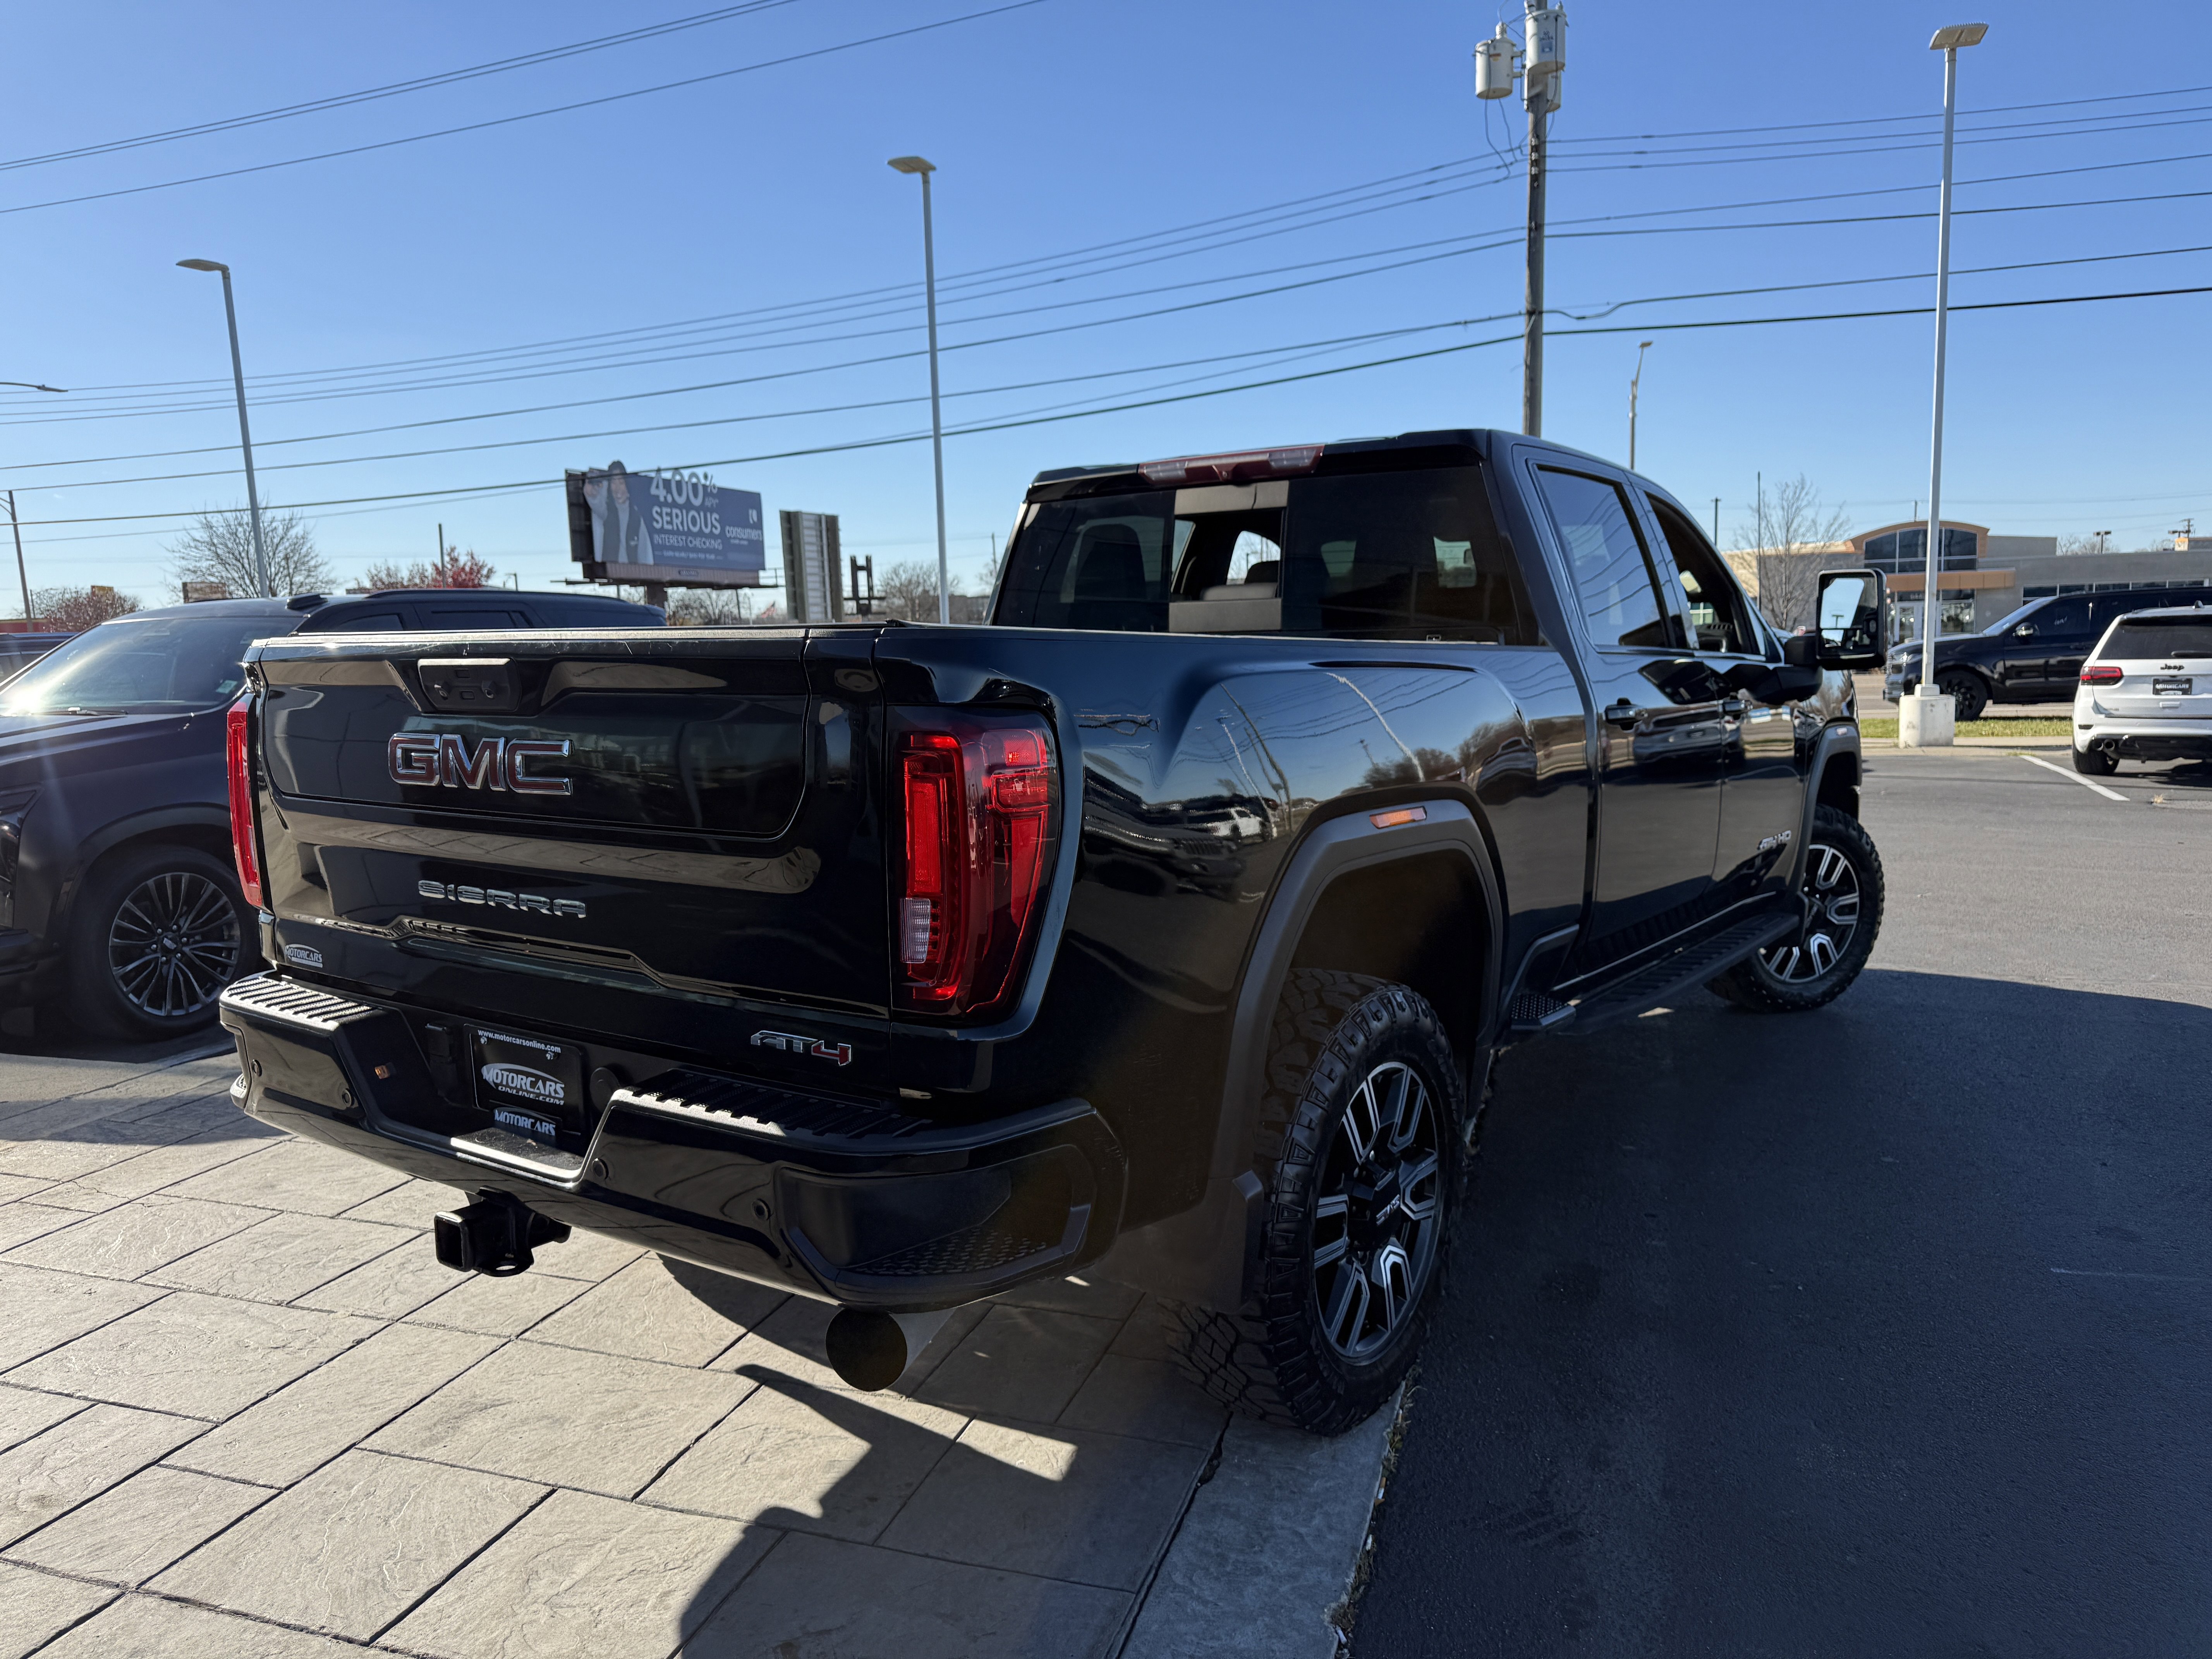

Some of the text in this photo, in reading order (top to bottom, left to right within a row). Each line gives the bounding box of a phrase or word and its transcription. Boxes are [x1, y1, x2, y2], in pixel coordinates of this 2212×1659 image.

[652, 505, 721, 535] SERIOUS
[653, 533, 686, 547] INTEREST
[687, 536, 723, 550] CHECKING
[388, 732, 574, 795] GMC
[418, 880, 586, 918] SIERRA
[285, 945, 322, 963] MOTORCARS
[478, 1030, 561, 1053] www.motorcarsonline.com
[751, 1030, 851, 1066] AT4
[483, 1066, 565, 1098] MOTORCARS
[498, 1085, 564, 1105] ONLINE.COM
[495, 1109, 556, 1136] MOTORCARS
